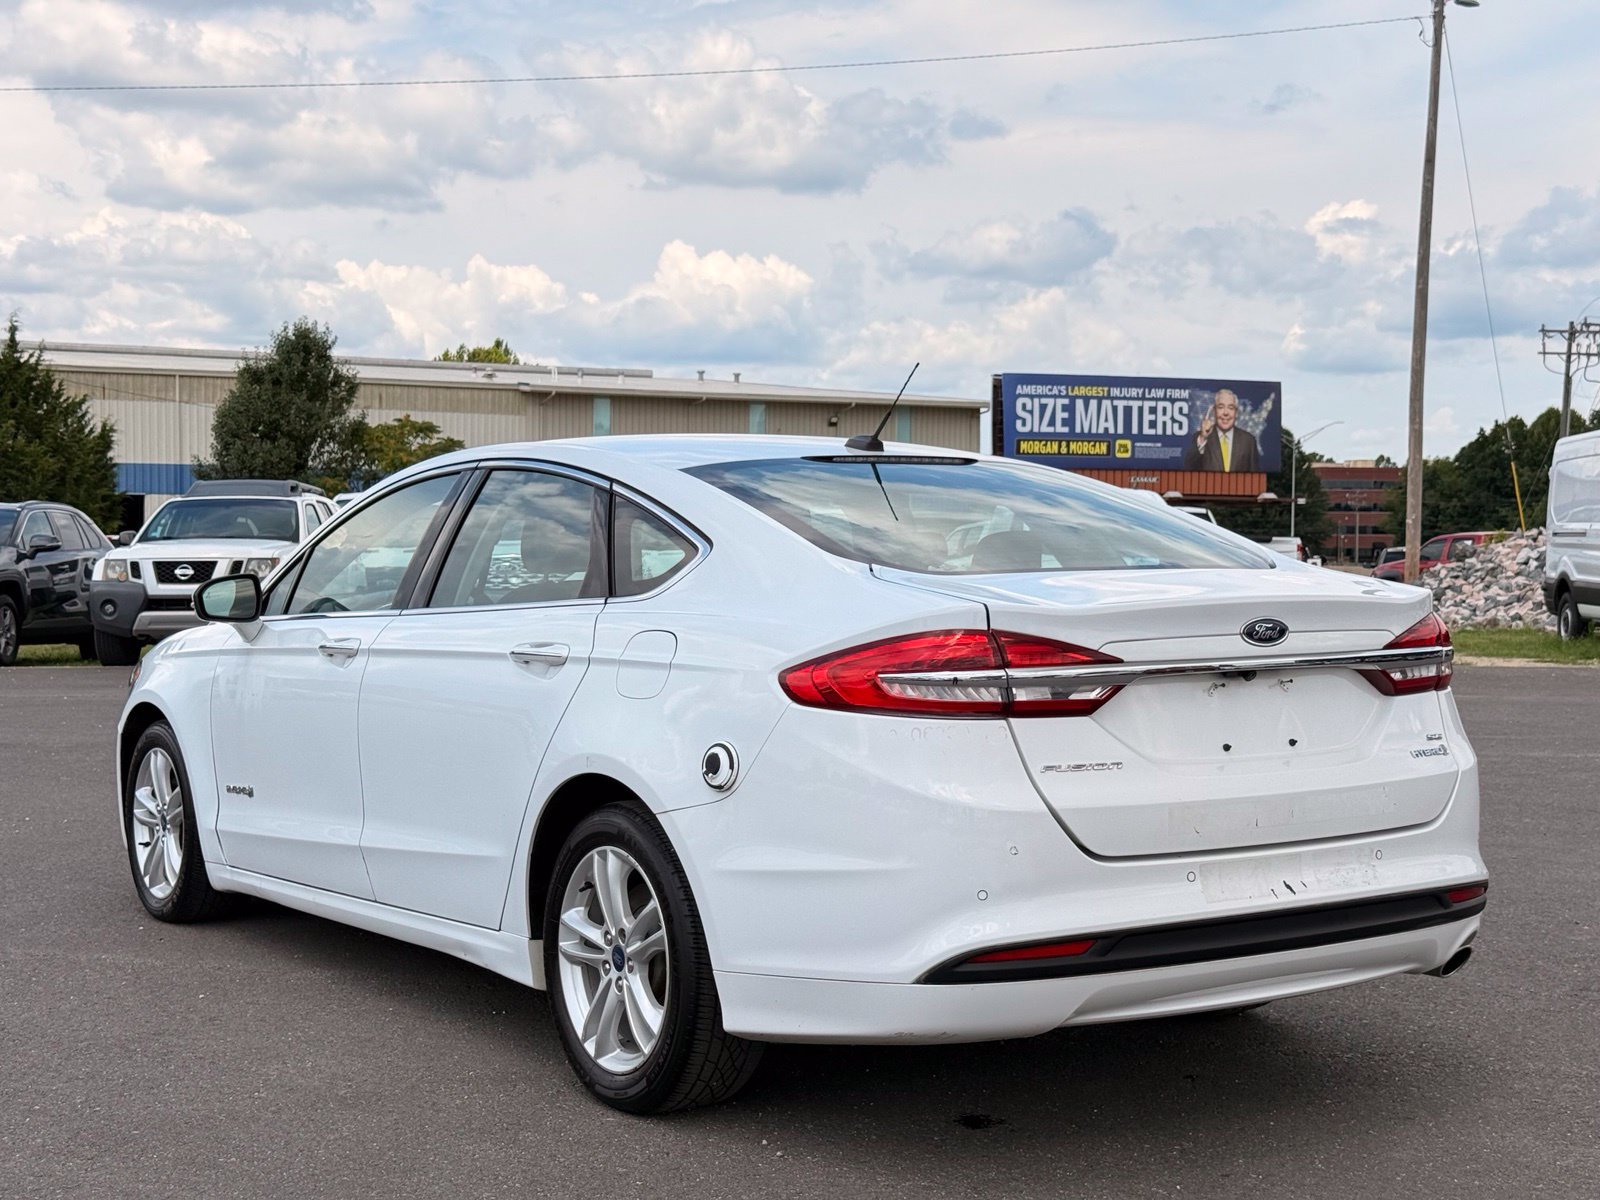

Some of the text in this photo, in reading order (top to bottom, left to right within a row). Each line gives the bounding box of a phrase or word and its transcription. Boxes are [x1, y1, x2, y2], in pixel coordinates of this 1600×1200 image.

[1015, 384, 1190, 399] AMERICA'S LARGEST INJURY LAW FIRM
[1015, 397, 1190, 436] SIZE MATTERS
[1020, 440, 1059, 454] MORGAN
[1060, 441, 1068, 454] &
[1069, 441, 1108, 455] MORGAN
[1252, 622, 1281, 640] Ford
[1039, 762, 1123, 774] FUSION
